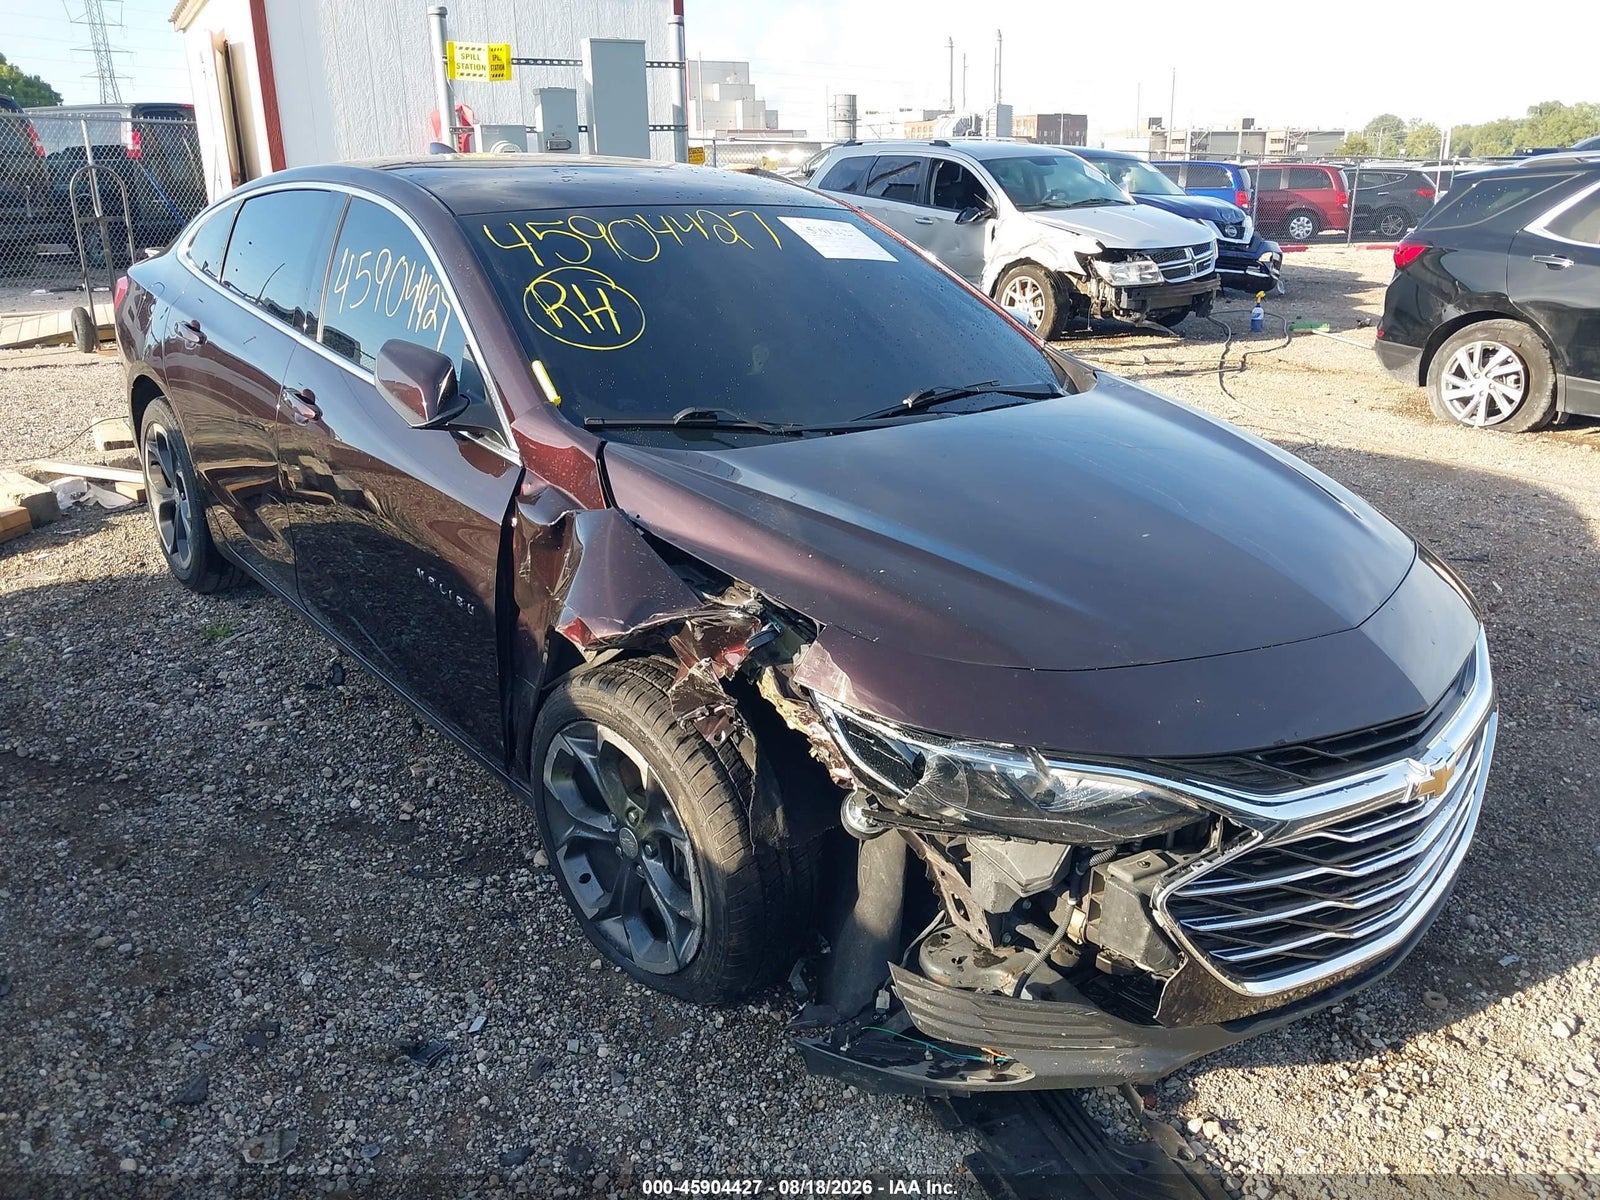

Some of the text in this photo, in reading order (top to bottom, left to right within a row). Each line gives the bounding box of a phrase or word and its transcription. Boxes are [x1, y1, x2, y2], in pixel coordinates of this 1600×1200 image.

[456, 62, 487, 71] STATION
[461, 53, 481, 61] SPILL
[483, 209, 783, 267] 45904427
[334, 248, 451, 352] 45904427
[531, 279, 621, 335] RH
